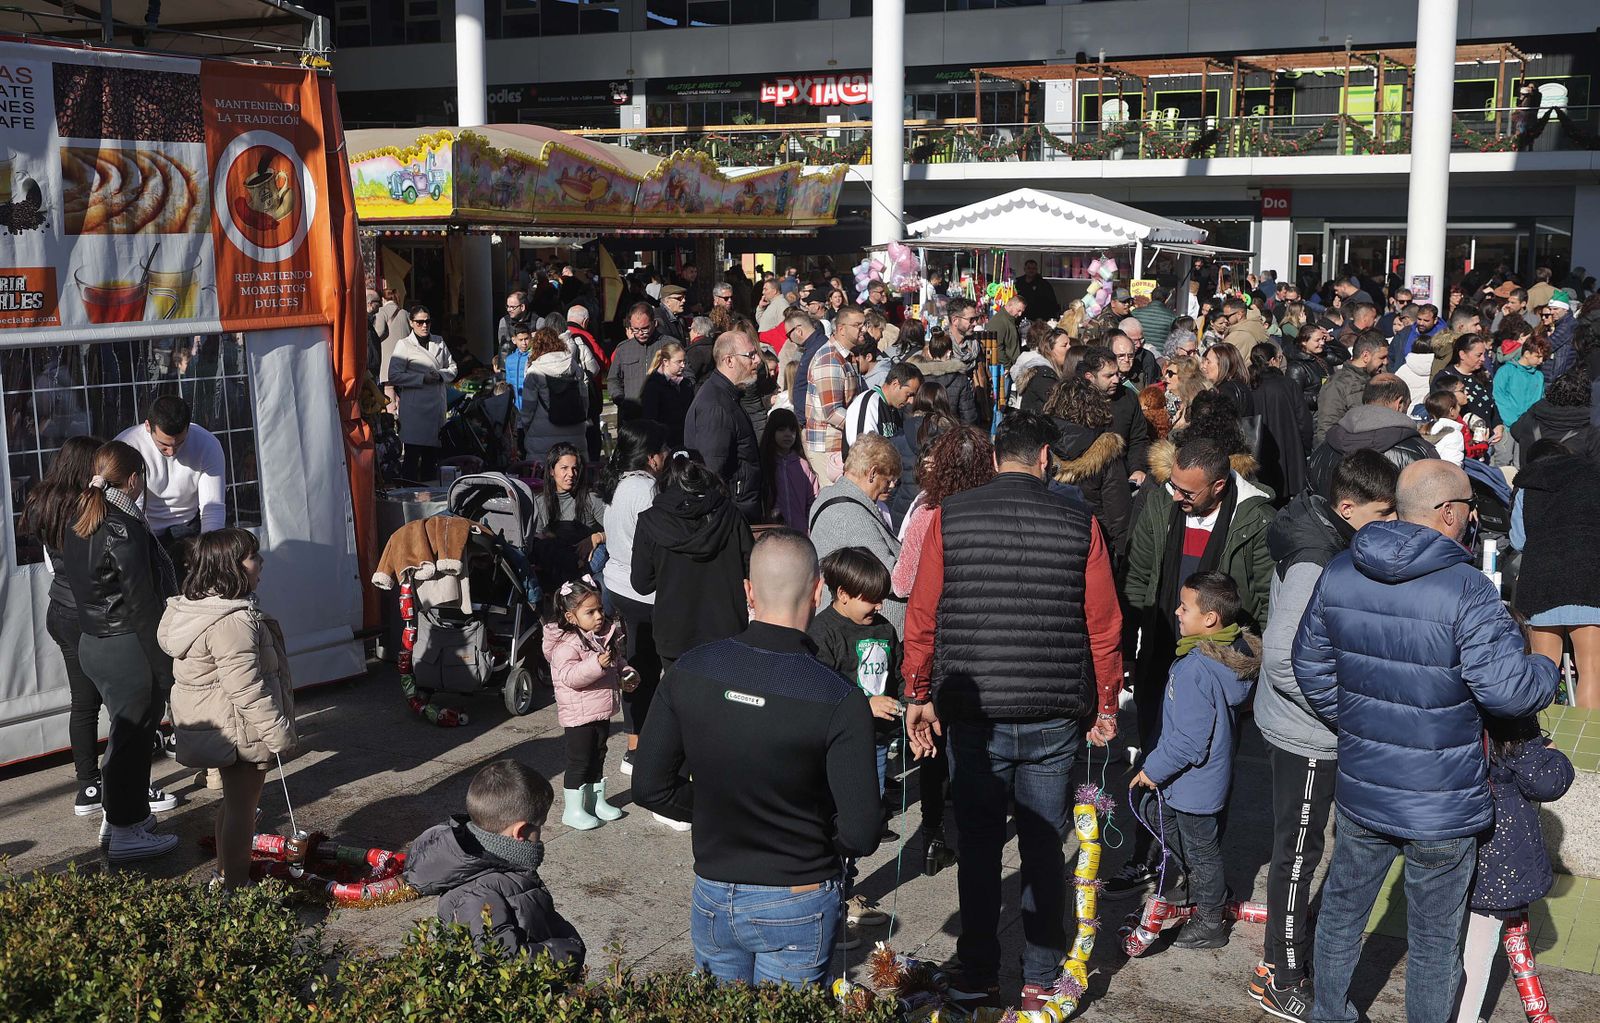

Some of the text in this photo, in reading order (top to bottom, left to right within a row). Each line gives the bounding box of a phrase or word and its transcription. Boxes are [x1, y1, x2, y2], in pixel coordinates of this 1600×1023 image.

[0, 65, 33, 84] AS
[0, 84, 35, 99] ATE
[215, 98, 300, 112] MANTENIENDO
[0, 116, 35, 130] AFE
[217, 112, 300, 125] LA TRADICIÓN
[235, 270, 313, 282] REPARTIENDO
[241, 284, 306, 296] MOMENTOS
[255, 297, 299, 309] DULCES
[863, 662, 885, 675] 2123
[729, 692, 755, 703] LACOSTE
[1285, 915, 1294, 939] ELEVEN
[1300, 802, 1312, 825] ELEVEN
